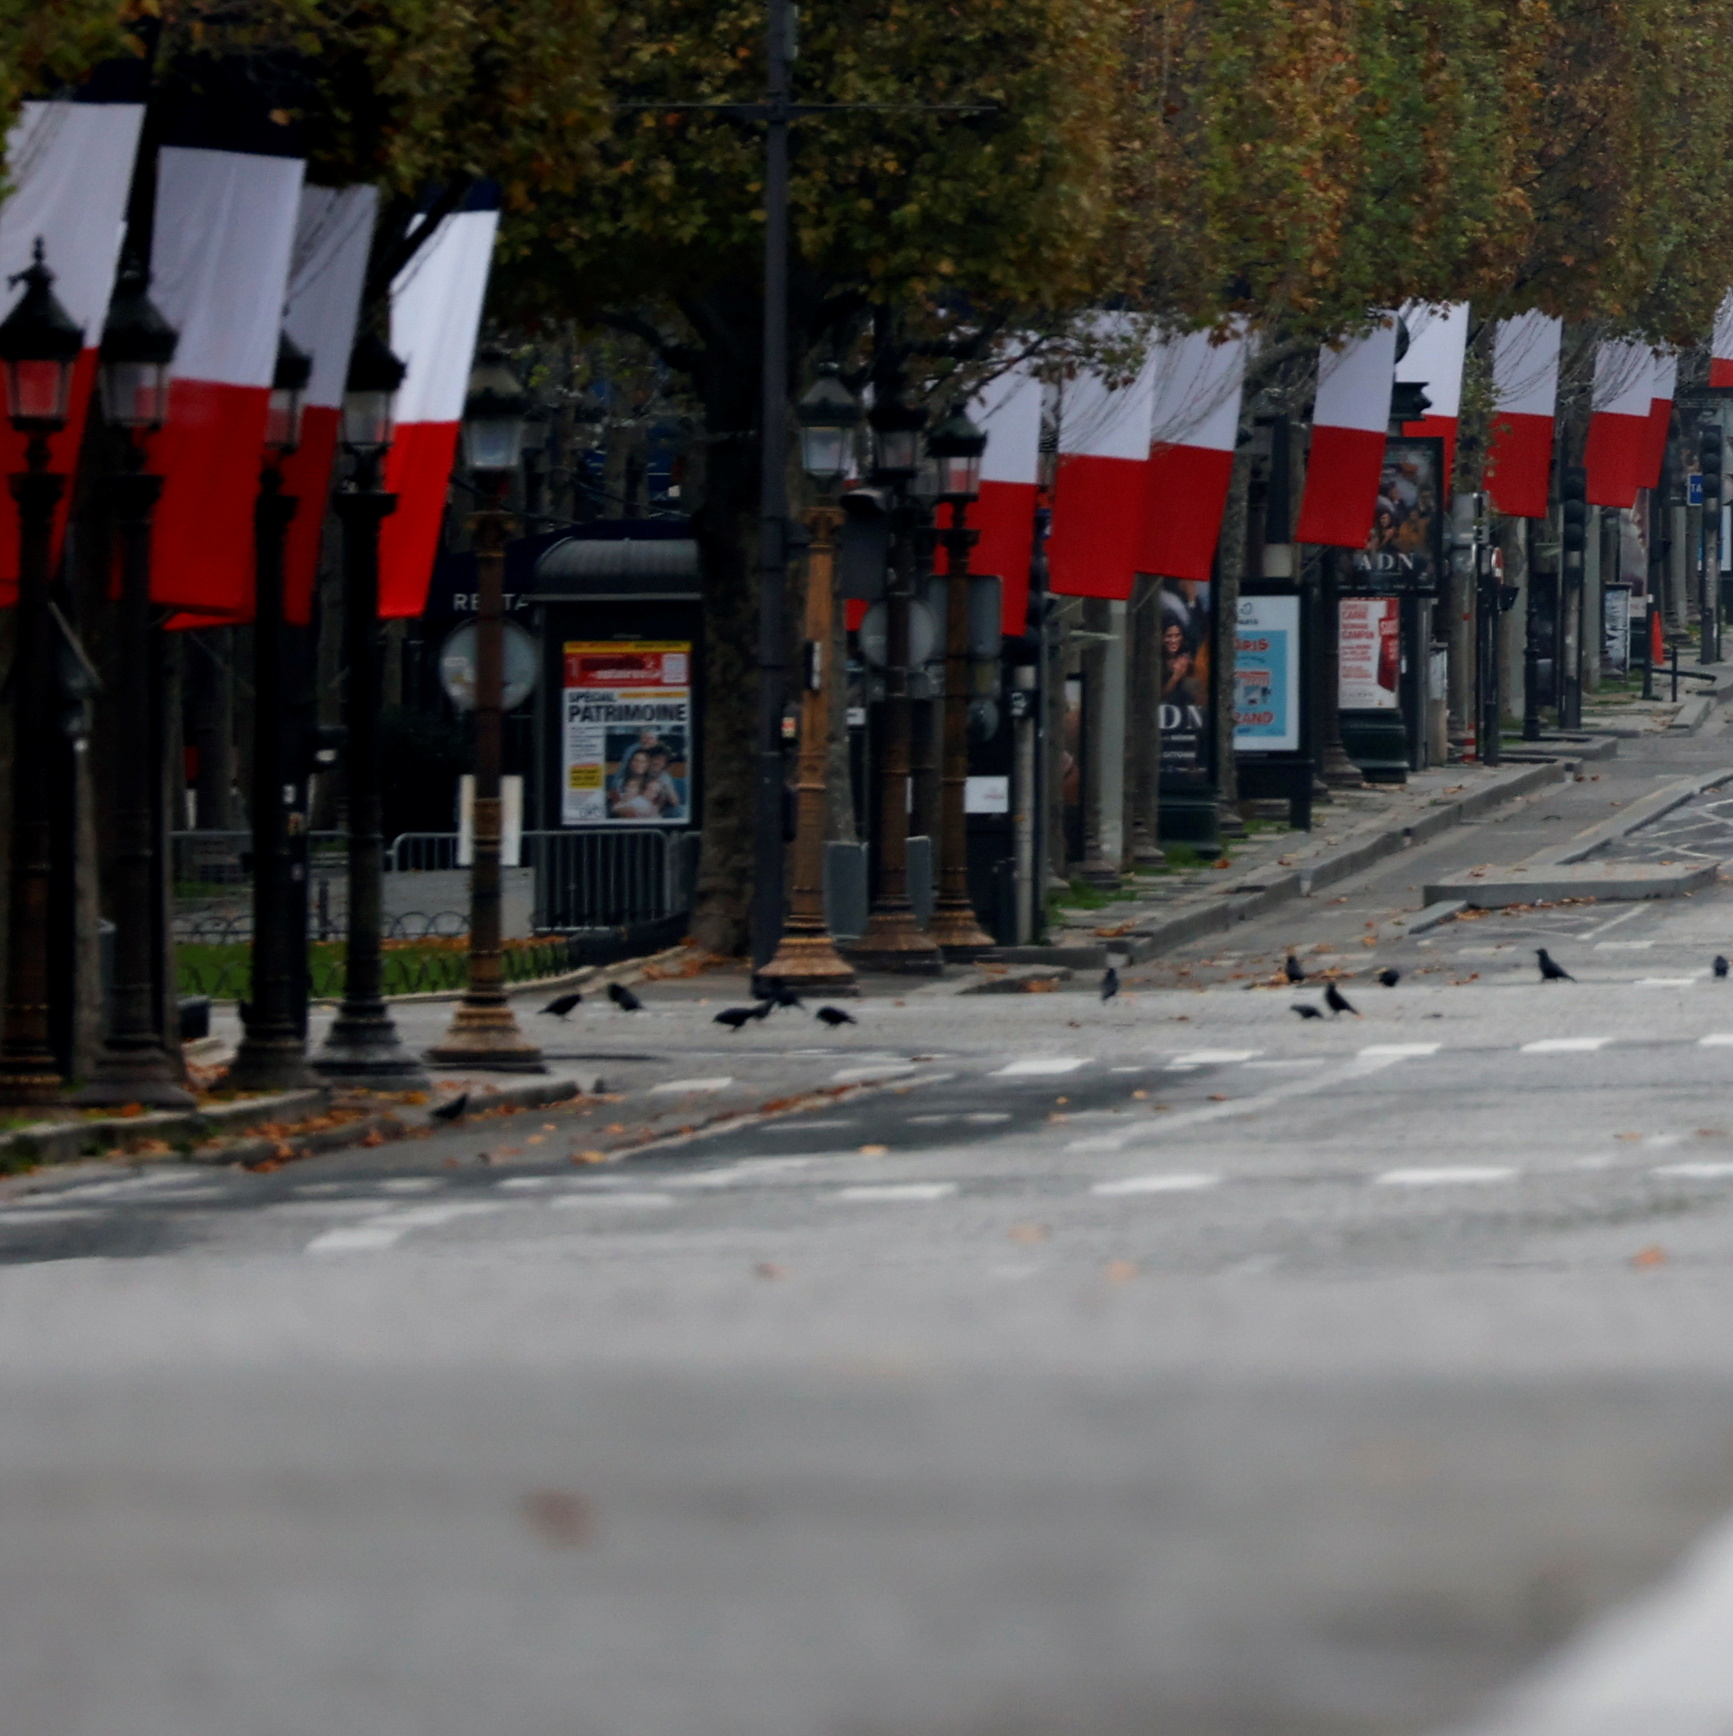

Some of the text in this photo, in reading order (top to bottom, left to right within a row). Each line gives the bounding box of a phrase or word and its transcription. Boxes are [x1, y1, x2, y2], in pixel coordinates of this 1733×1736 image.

[1358, 552, 1414, 570] ADN
[453, 593, 529, 611] RETA
[568, 704, 688, 723] PATRIMOINE
